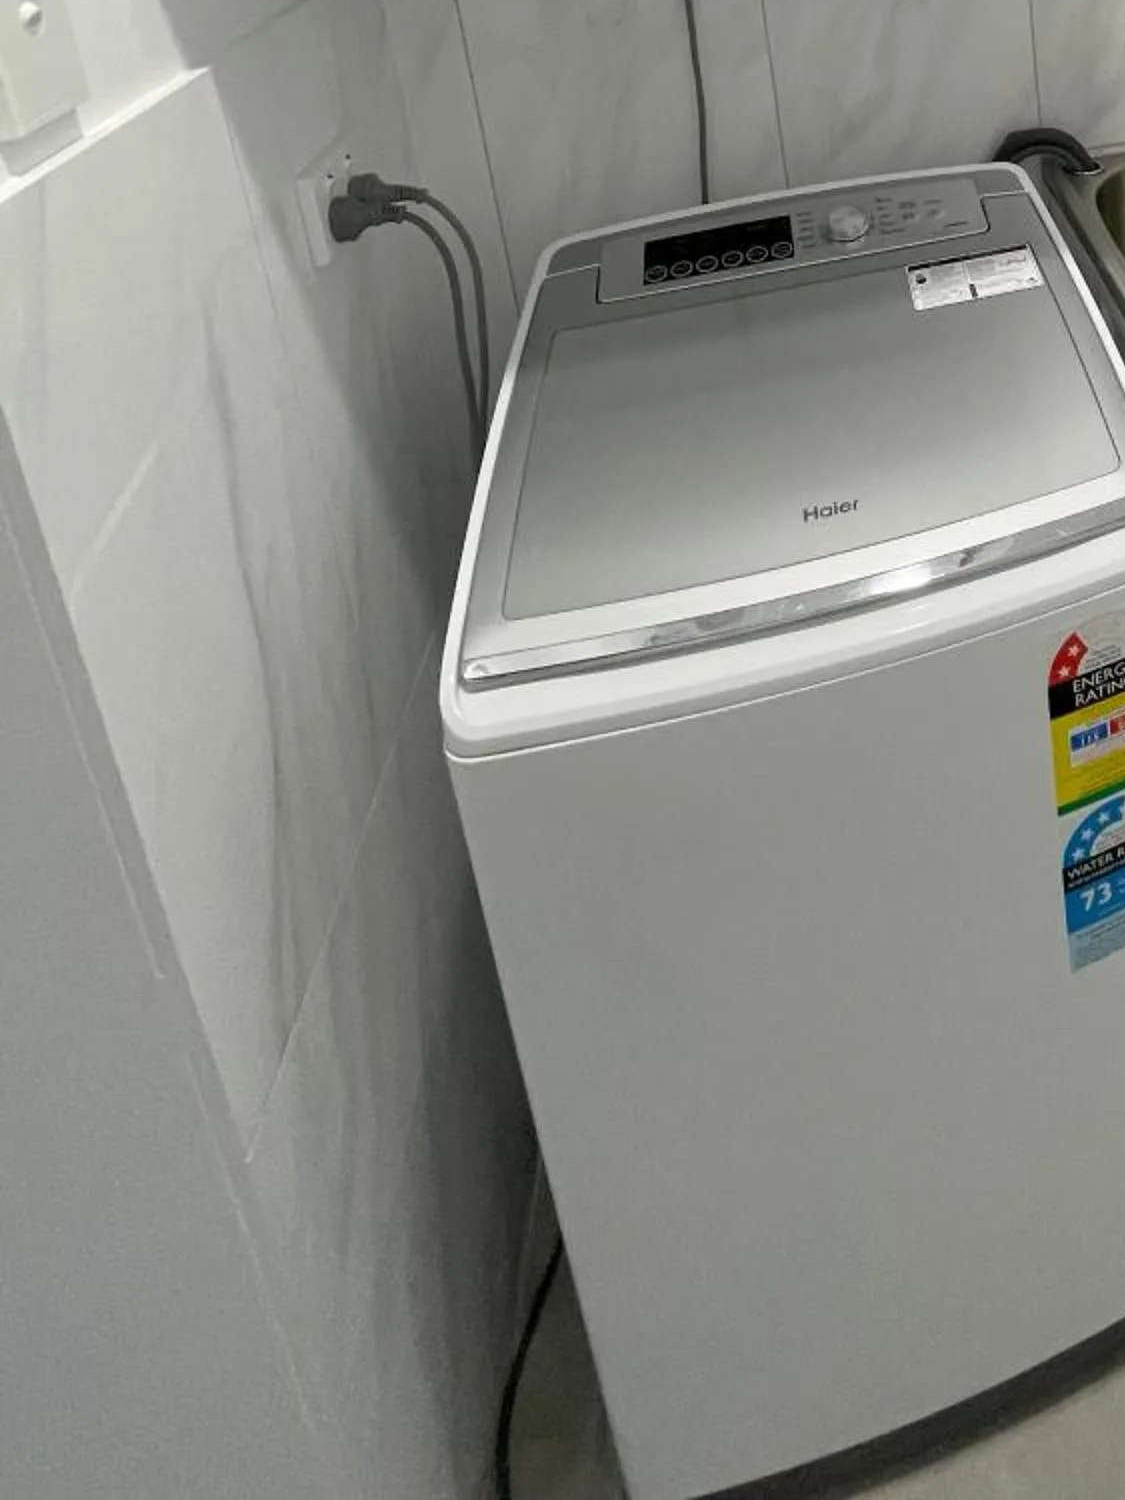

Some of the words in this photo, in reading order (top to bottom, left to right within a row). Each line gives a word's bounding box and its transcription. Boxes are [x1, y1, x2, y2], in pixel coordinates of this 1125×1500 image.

[802, 499, 859, 522] Haier
[1067, 852, 1114, 879] WATER
[1081, 881, 1113, 912] 73
